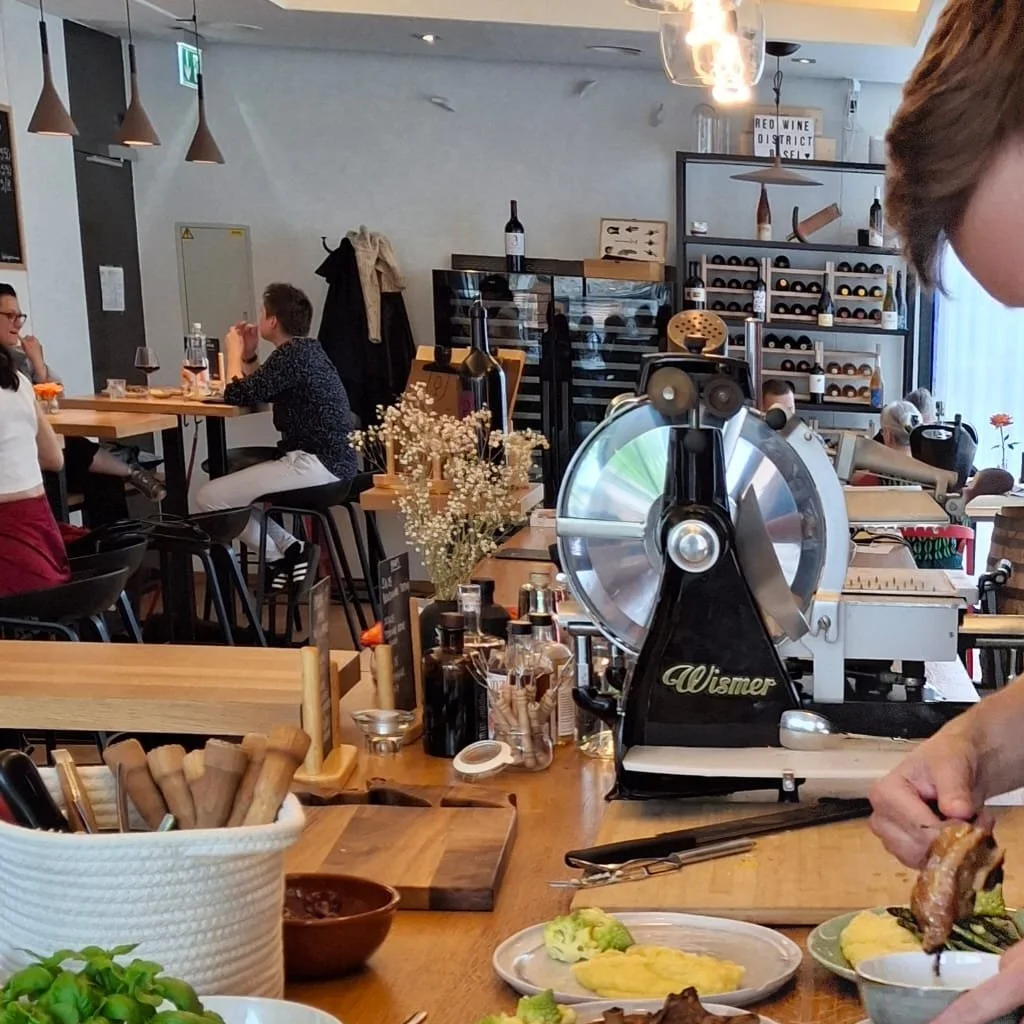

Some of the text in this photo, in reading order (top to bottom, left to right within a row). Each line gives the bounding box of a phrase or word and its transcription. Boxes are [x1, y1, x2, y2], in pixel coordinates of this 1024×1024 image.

[755, 118, 809, 132] RED WINE
[758, 134, 812, 146] DISTRICT
[662, 664, 778, 696] Wismer
